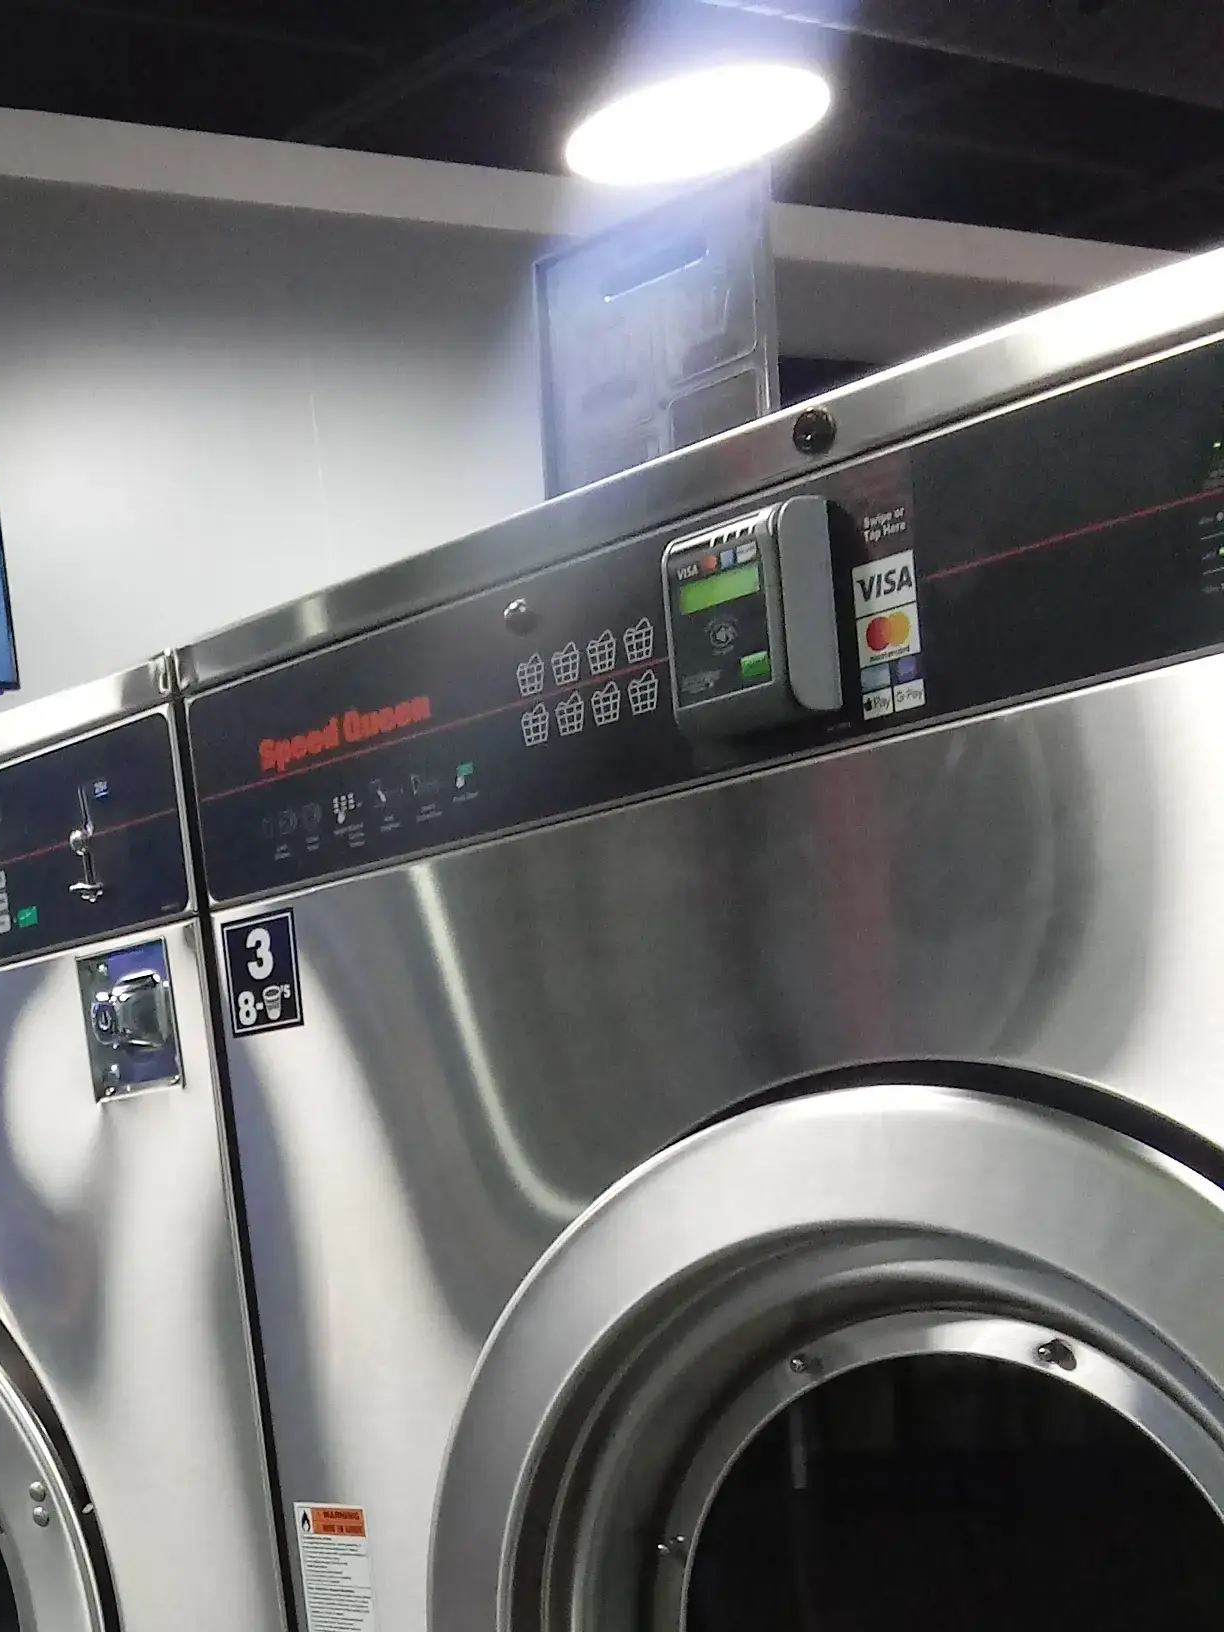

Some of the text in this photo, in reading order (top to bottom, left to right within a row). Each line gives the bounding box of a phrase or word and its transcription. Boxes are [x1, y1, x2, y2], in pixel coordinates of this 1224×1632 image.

[677, 564, 699, 580] VISA
[856, 566, 912, 601] VISA
[259, 697, 431, 771] Speed Queen
[245, 927, 274, 980] 3
